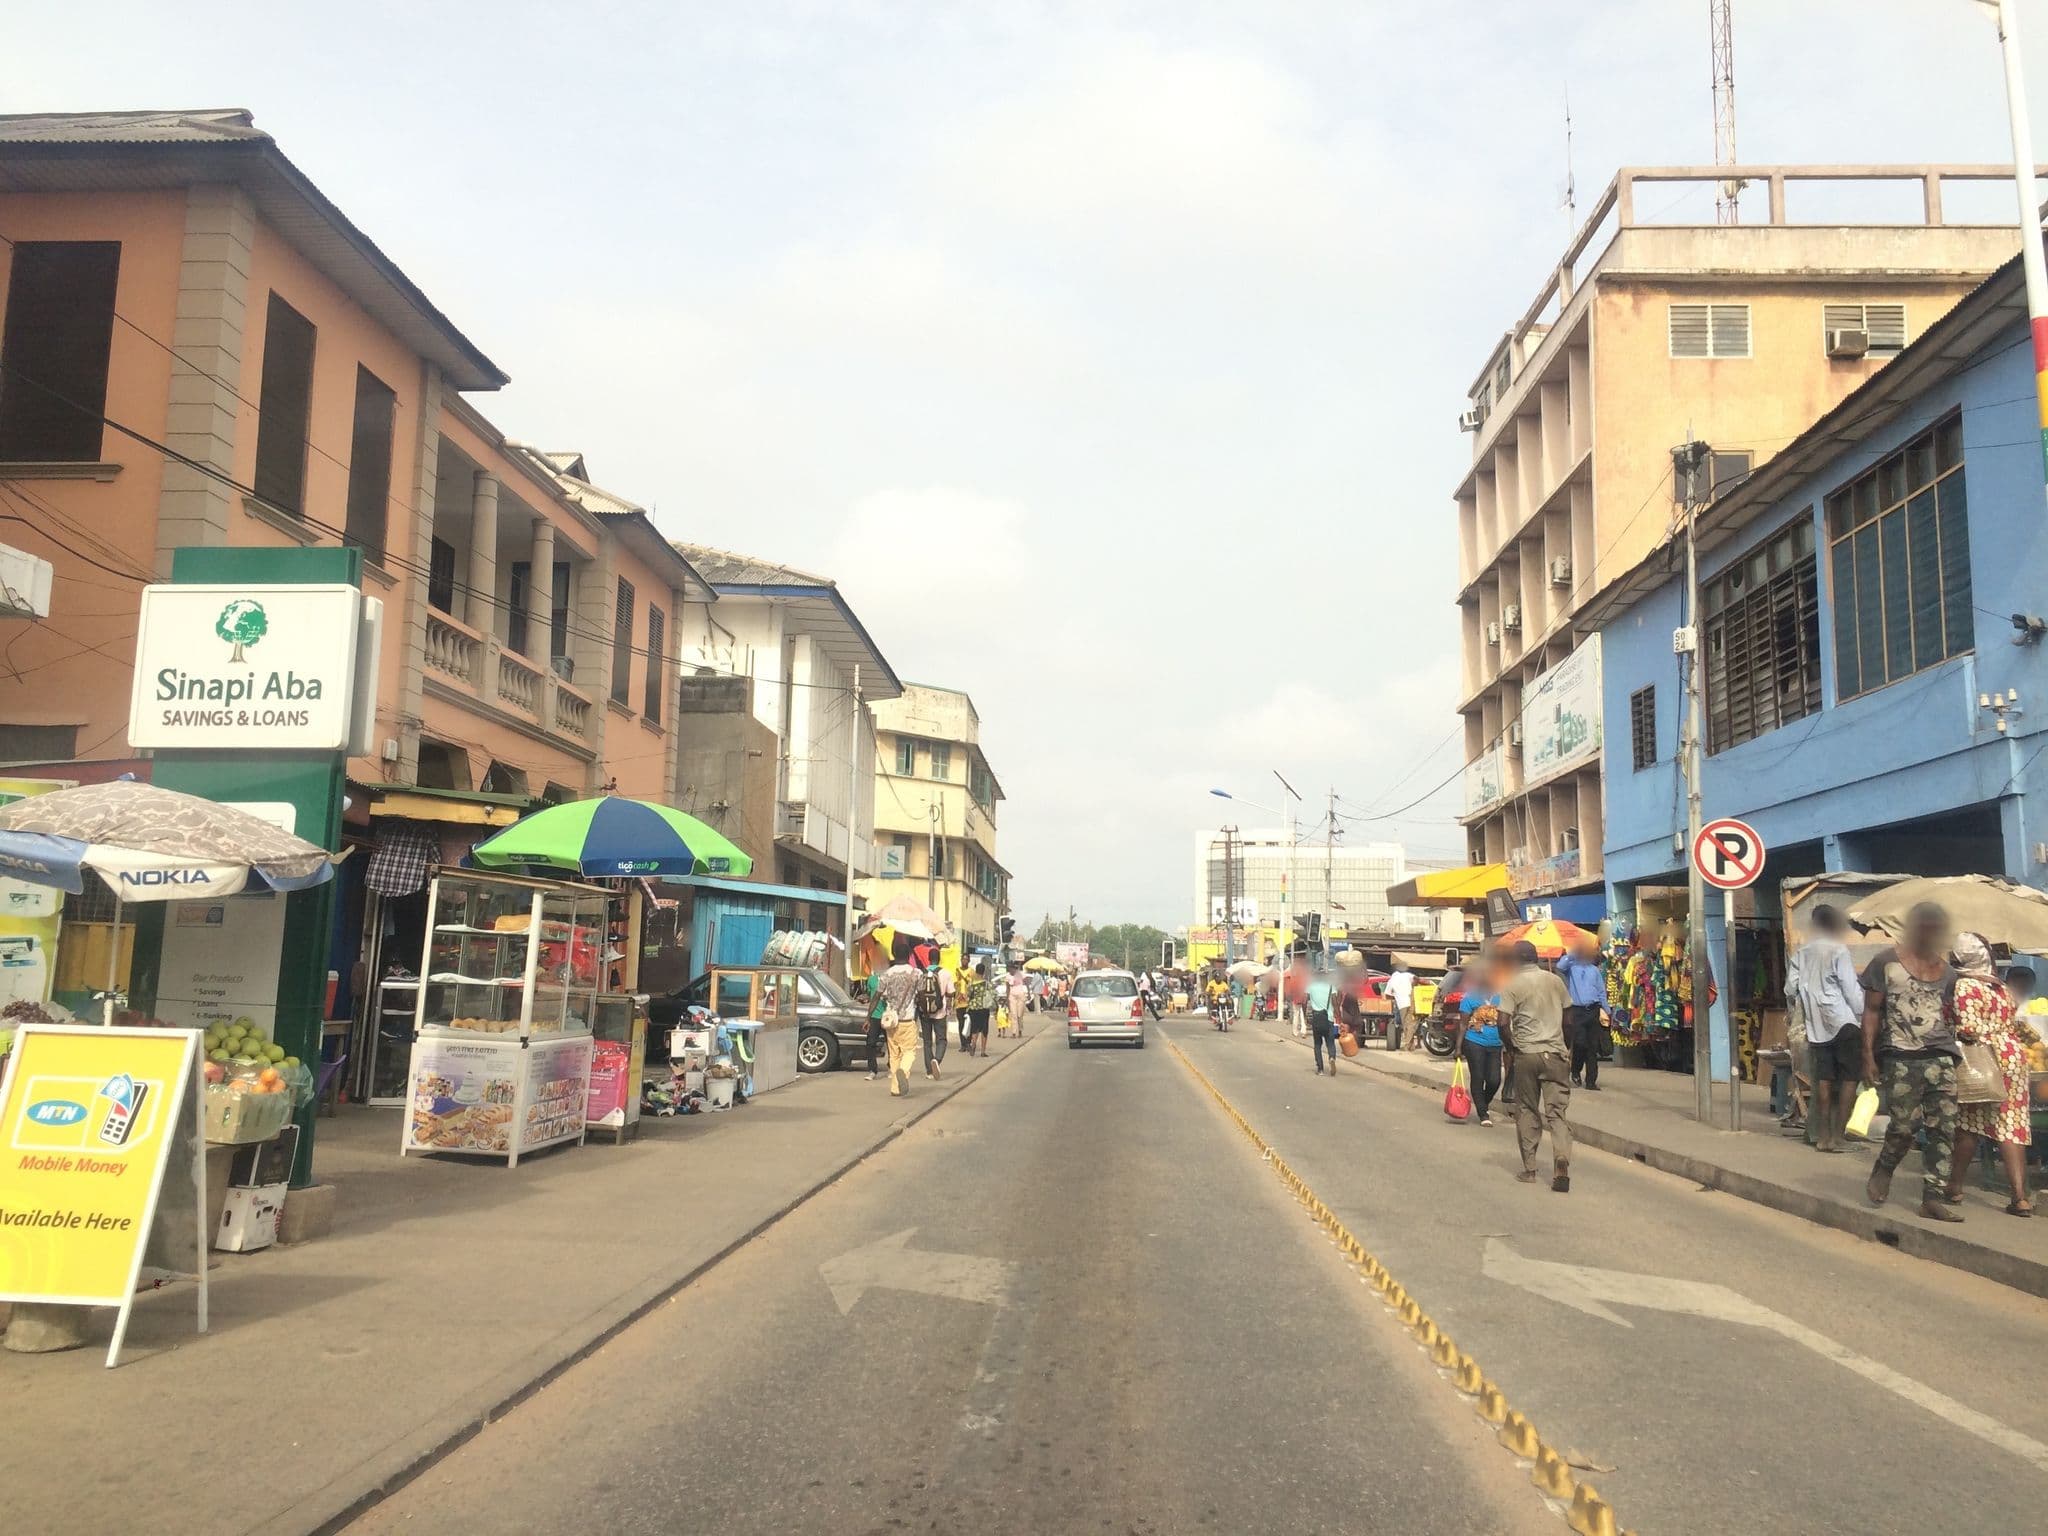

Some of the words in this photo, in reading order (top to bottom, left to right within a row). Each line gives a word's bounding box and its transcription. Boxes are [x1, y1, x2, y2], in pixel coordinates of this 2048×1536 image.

[1675, 641, 1686, 650] 24
[156, 668, 255, 707] Sinapi
[262, 670, 323, 701] Aba
[162, 710, 233, 727] SAVINGS
[237, 710, 250, 727] &
[253, 710, 309, 727] LOANS
[1715, 832, 1748, 876] P
[120, 869, 211, 887] NOKIA
[199, 988, 226, 997] Savings
[36, 1104, 79, 1121] MTN
[18, 1155, 73, 1172] Mobile
[74, 1157, 129, 1177] Money
[85, 1212, 132, 1231] Here
